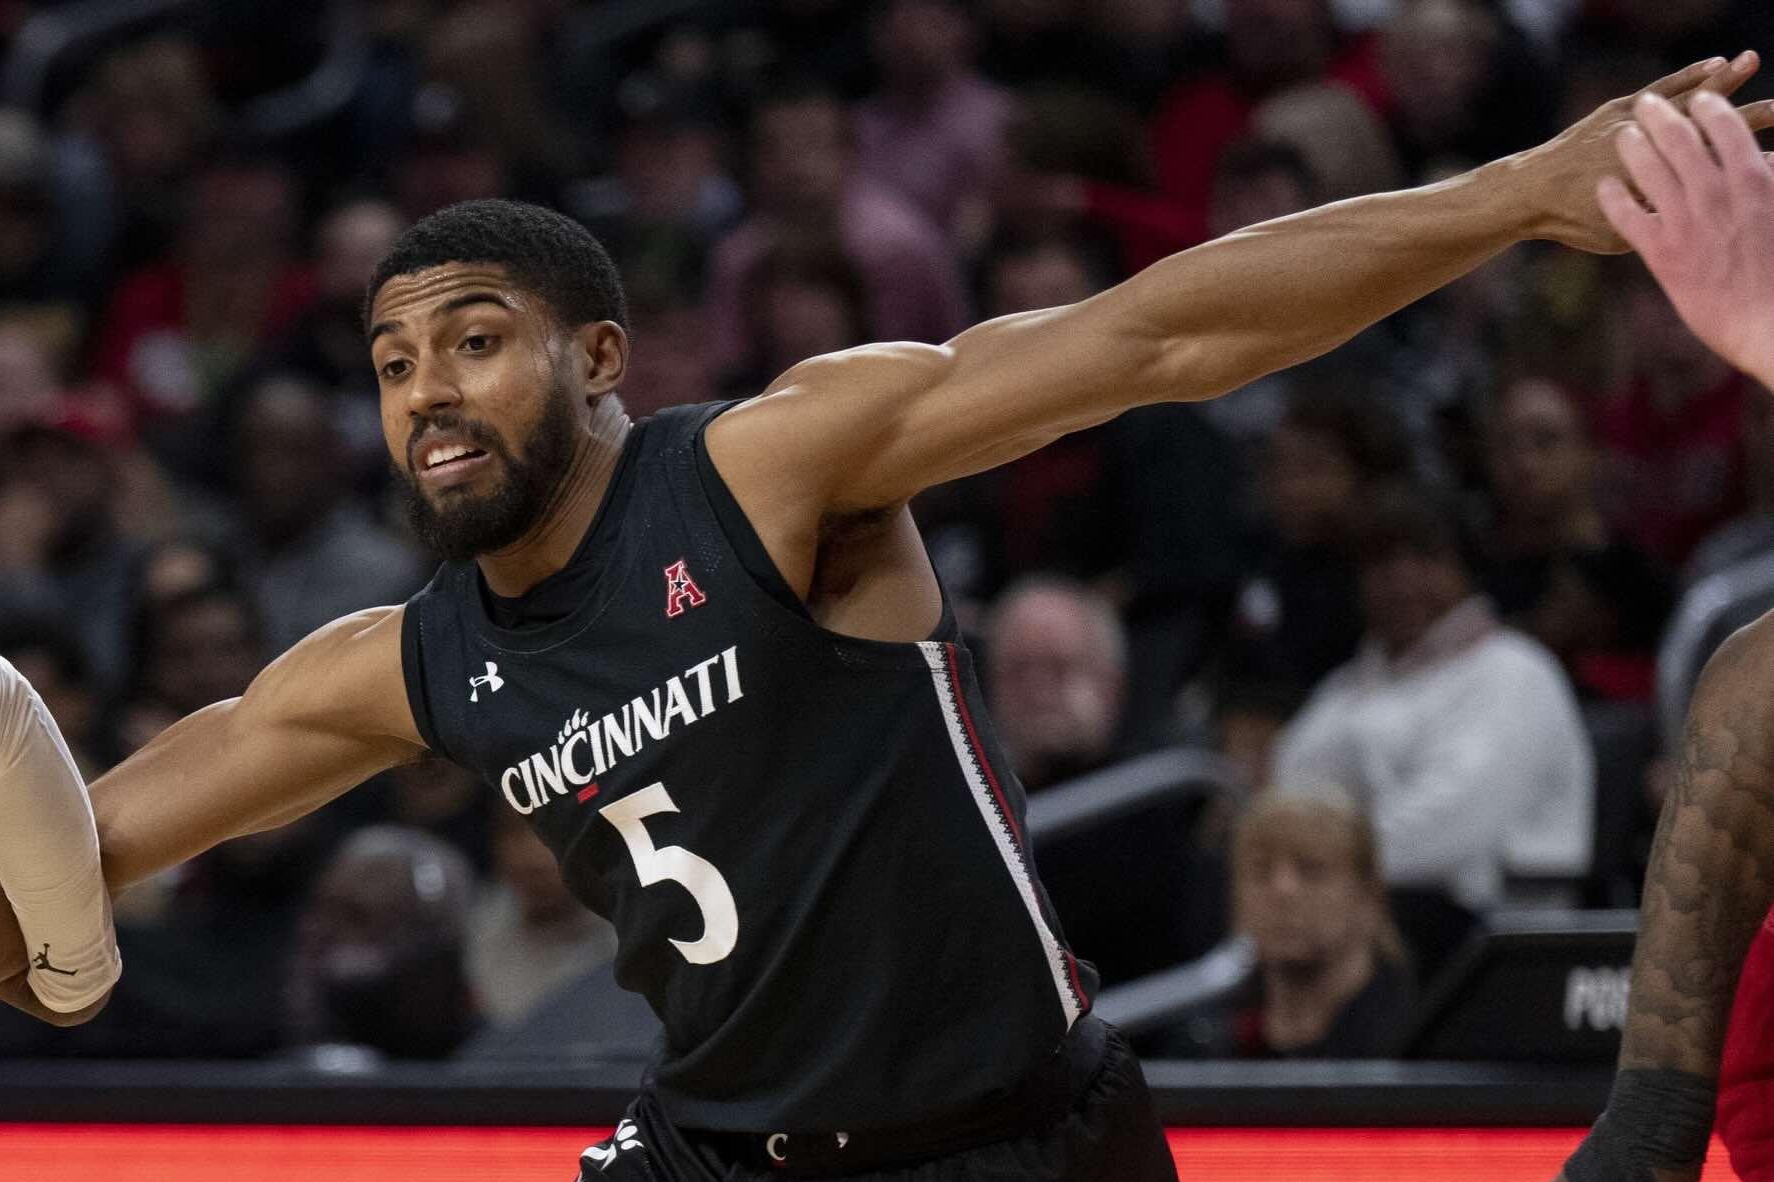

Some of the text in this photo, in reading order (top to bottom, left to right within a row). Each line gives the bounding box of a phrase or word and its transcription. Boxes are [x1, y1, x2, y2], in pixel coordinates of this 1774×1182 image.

[665, 560, 706, 618] A
[501, 646, 744, 815] CINCINNATI
[598, 782, 739, 965] 5
